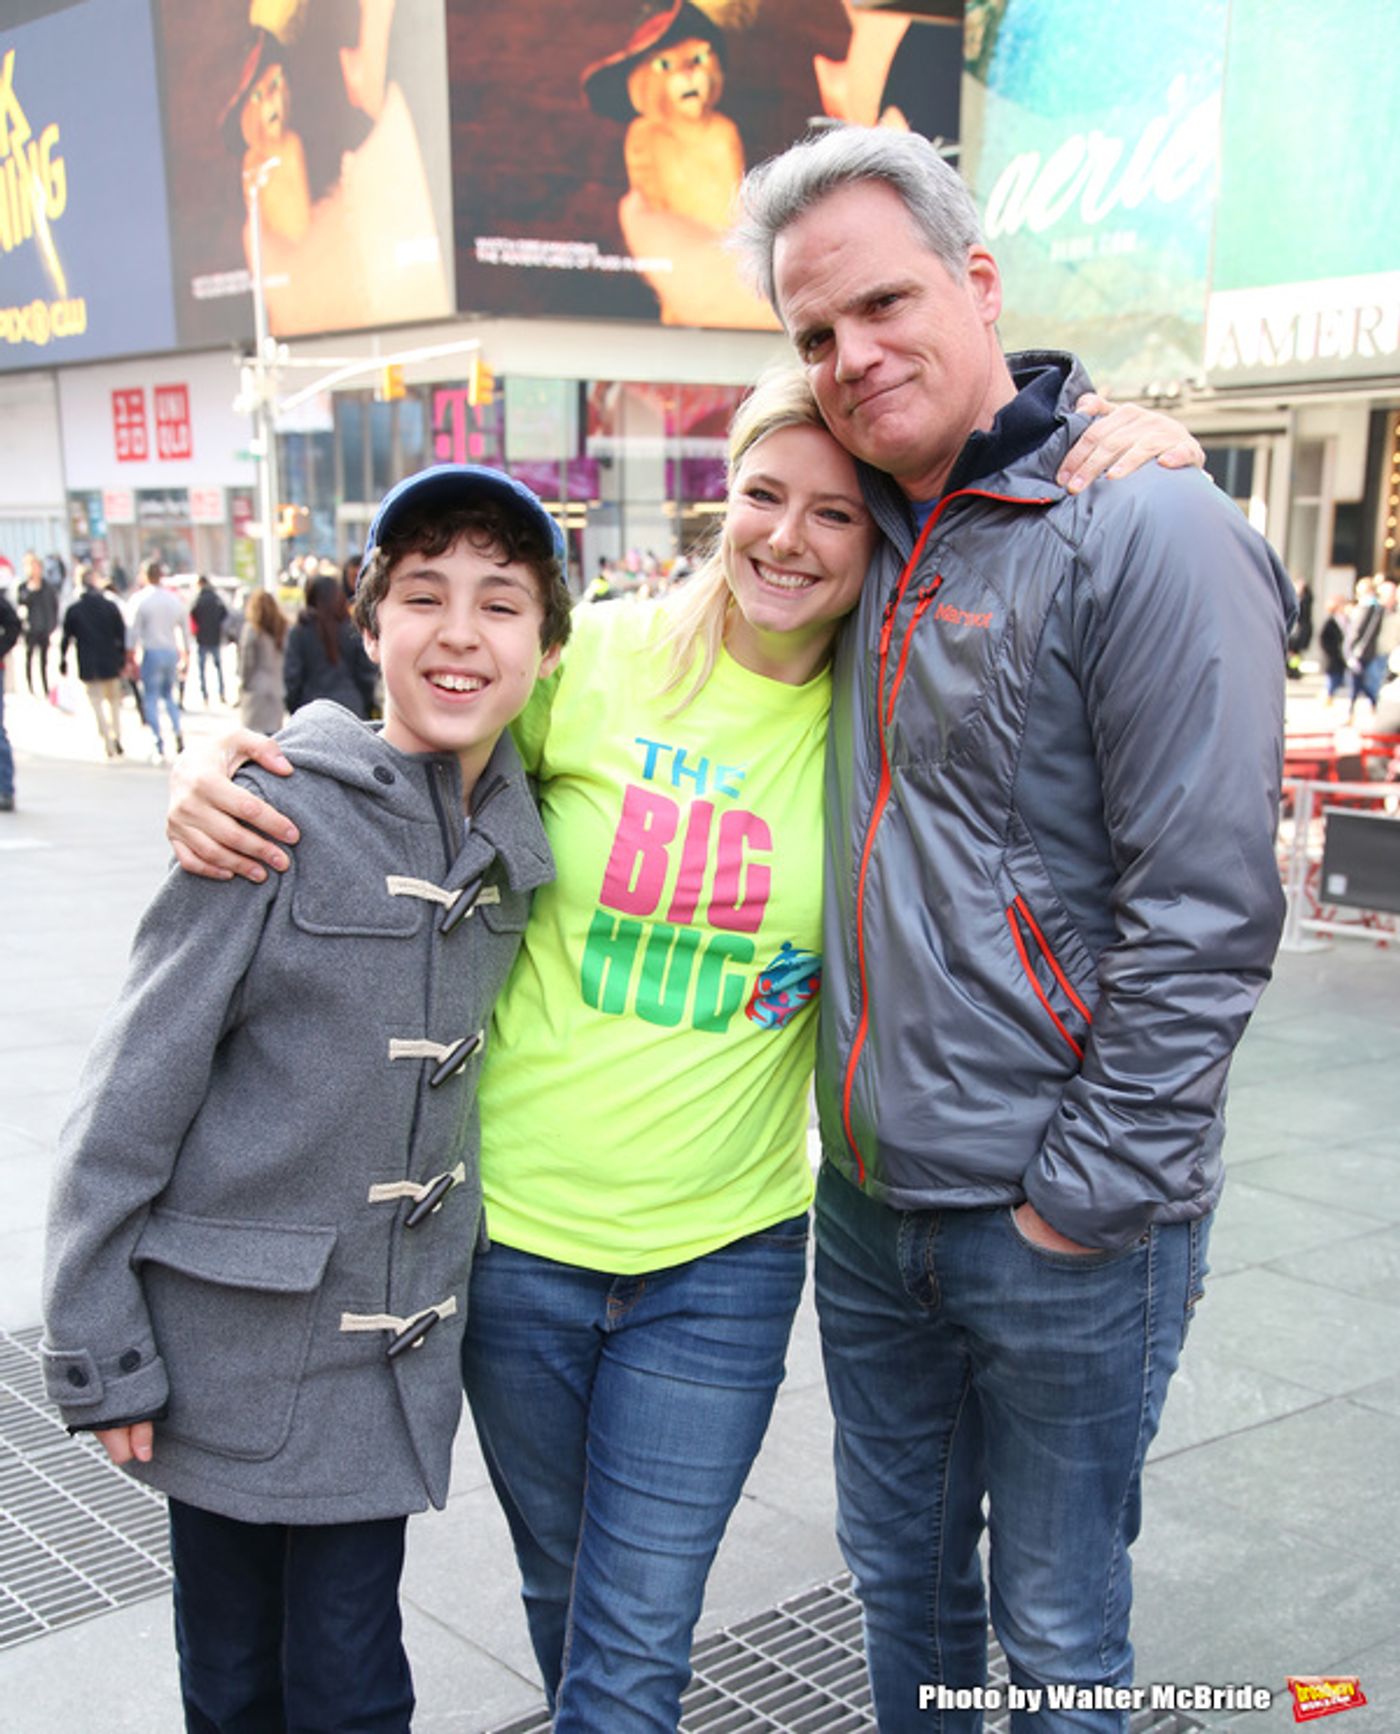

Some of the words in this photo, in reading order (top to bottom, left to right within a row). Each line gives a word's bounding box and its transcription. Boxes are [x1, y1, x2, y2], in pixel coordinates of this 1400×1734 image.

[1206, 302, 1400, 371] AMER
[635, 737, 746, 799] THE
[599, 783, 773, 934] BIG
